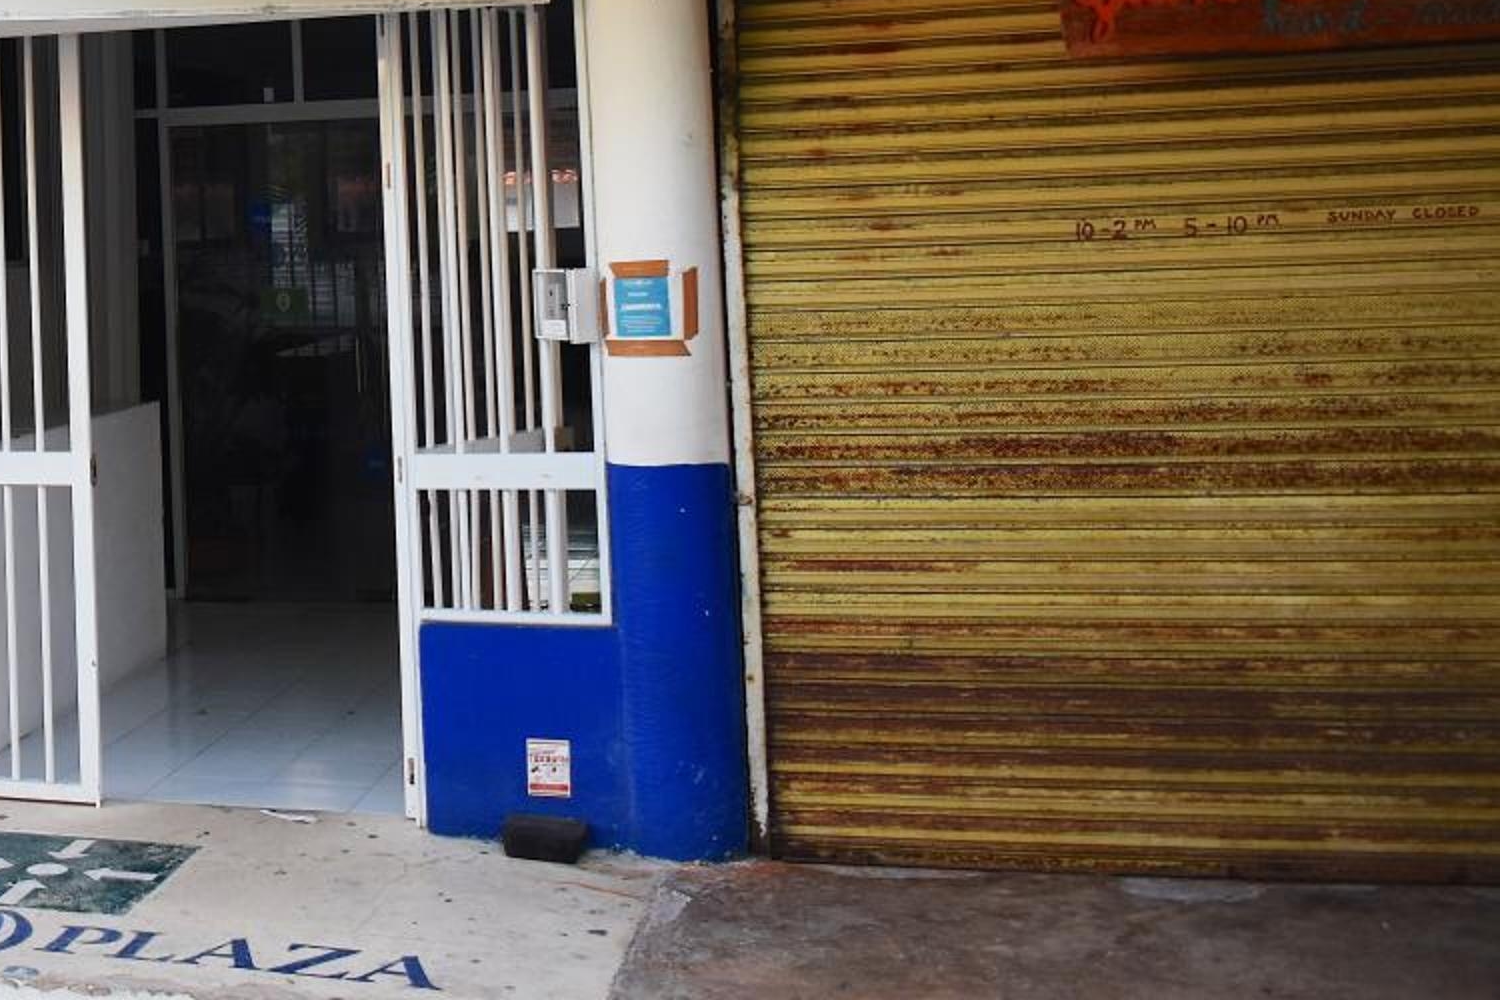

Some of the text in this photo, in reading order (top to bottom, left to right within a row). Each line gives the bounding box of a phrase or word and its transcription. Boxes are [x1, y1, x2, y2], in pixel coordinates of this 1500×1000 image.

[1326, 207, 1397, 225] SUNDAY
[1411, 204, 1481, 220] CLOSED
[32, 924, 444, 992] PLAZA
